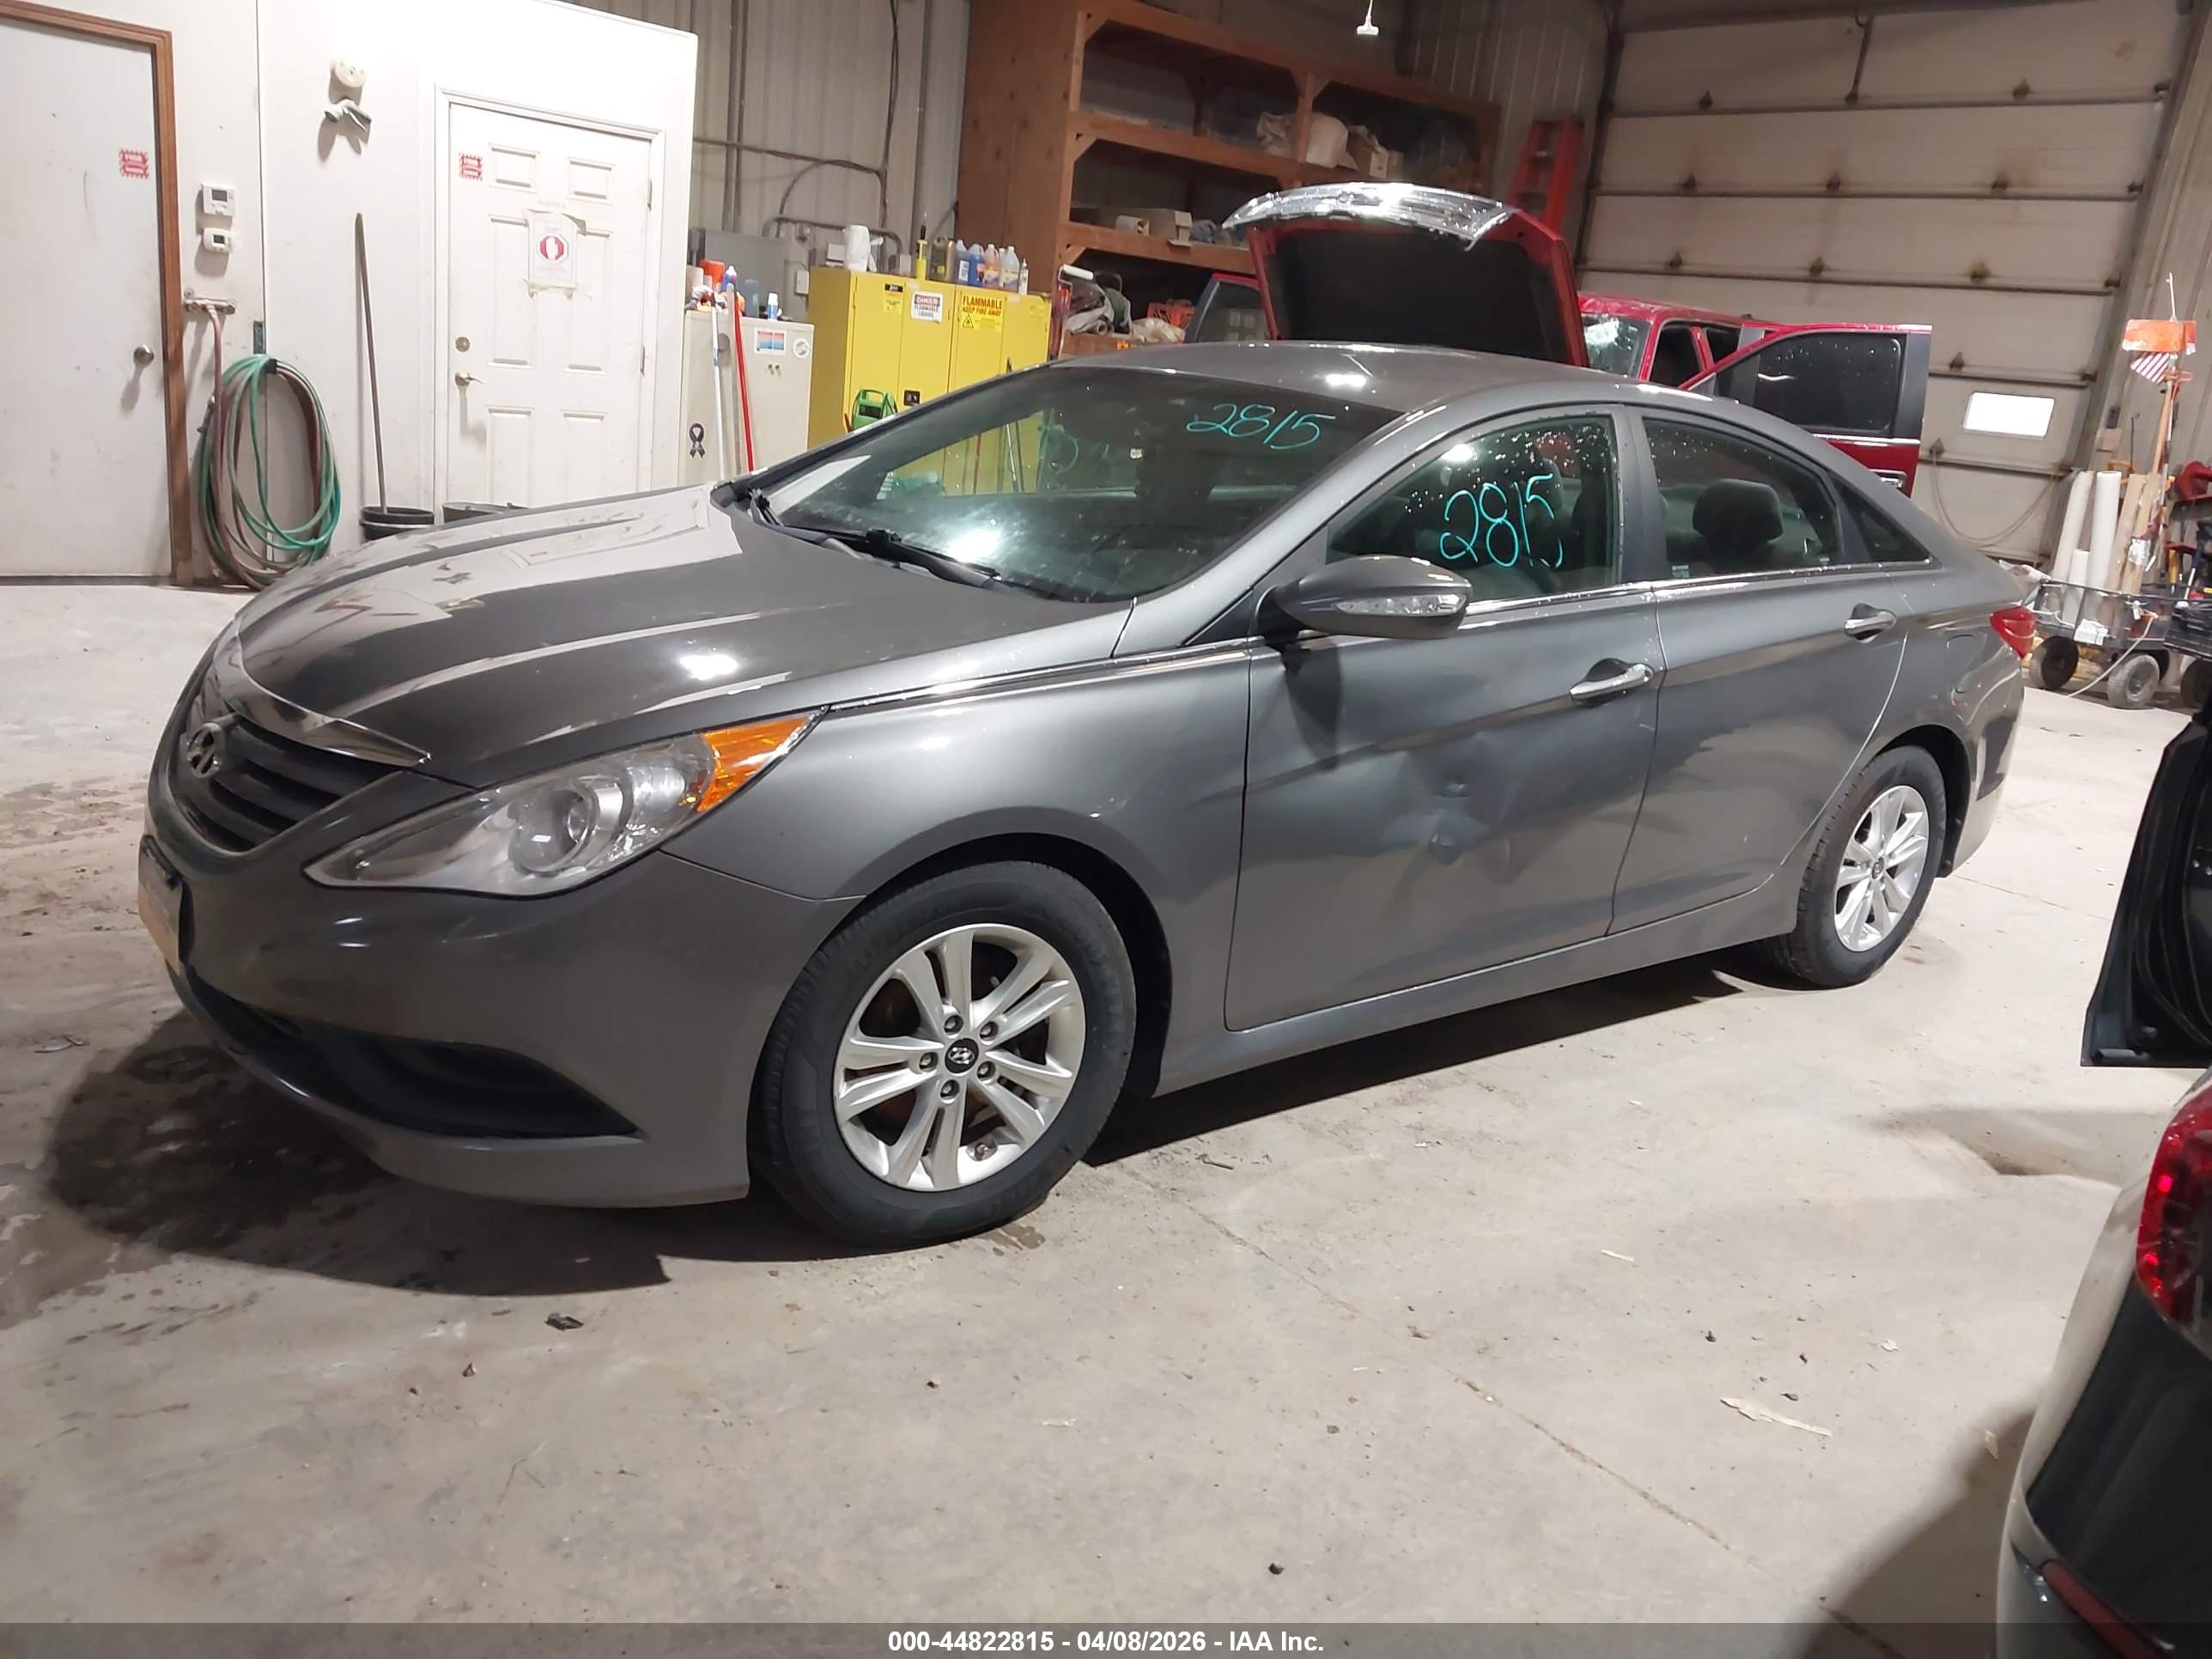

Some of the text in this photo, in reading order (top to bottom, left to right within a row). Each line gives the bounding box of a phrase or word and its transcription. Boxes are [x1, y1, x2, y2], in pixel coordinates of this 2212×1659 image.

[963, 295, 1003, 310] FLAMMABLE
[1186, 403, 1337, 450] 2815
[1439, 473, 1564, 568] 2815
